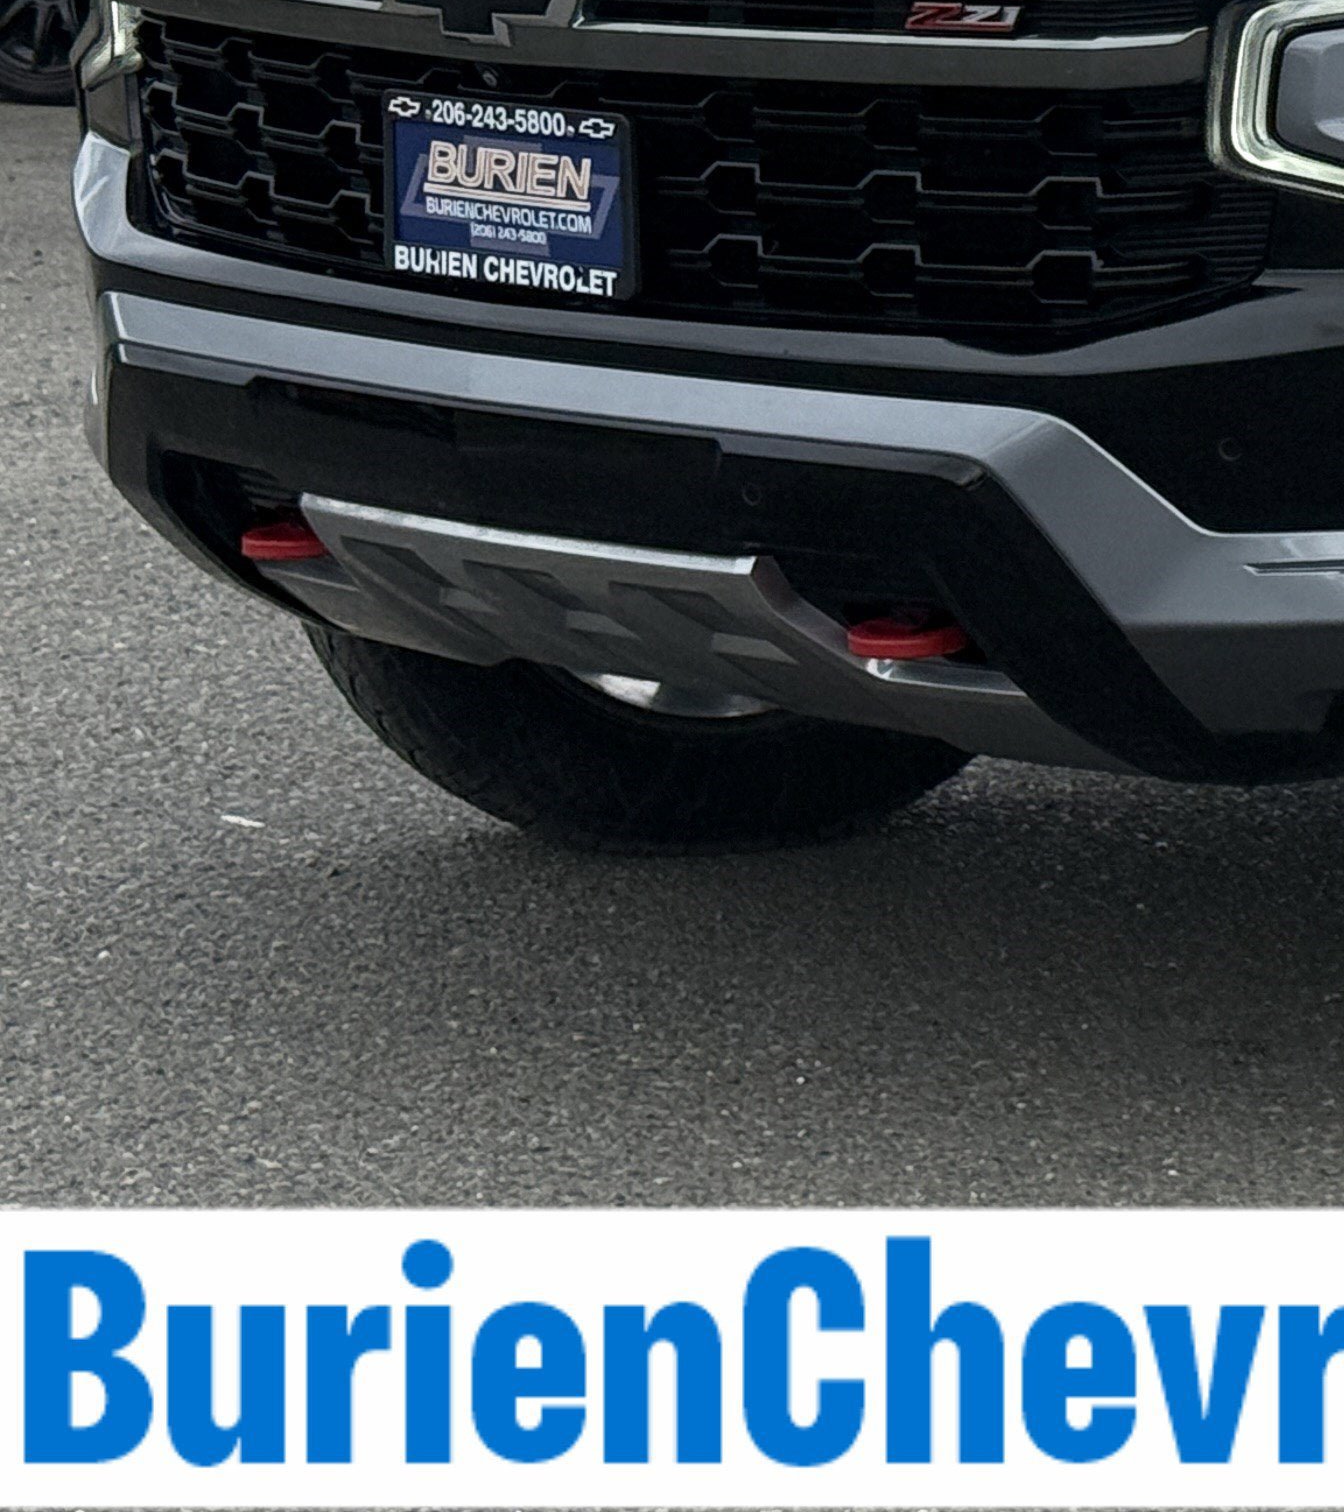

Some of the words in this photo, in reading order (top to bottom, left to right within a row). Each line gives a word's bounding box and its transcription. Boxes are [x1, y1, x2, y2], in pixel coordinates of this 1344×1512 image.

[905, 1, 1022, 33] Z71
[431, 99, 566, 137] 206-243-5800
[427, 140, 592, 200] BURIEN
[426, 196, 593, 234] BURIENCHEVROLET.COM
